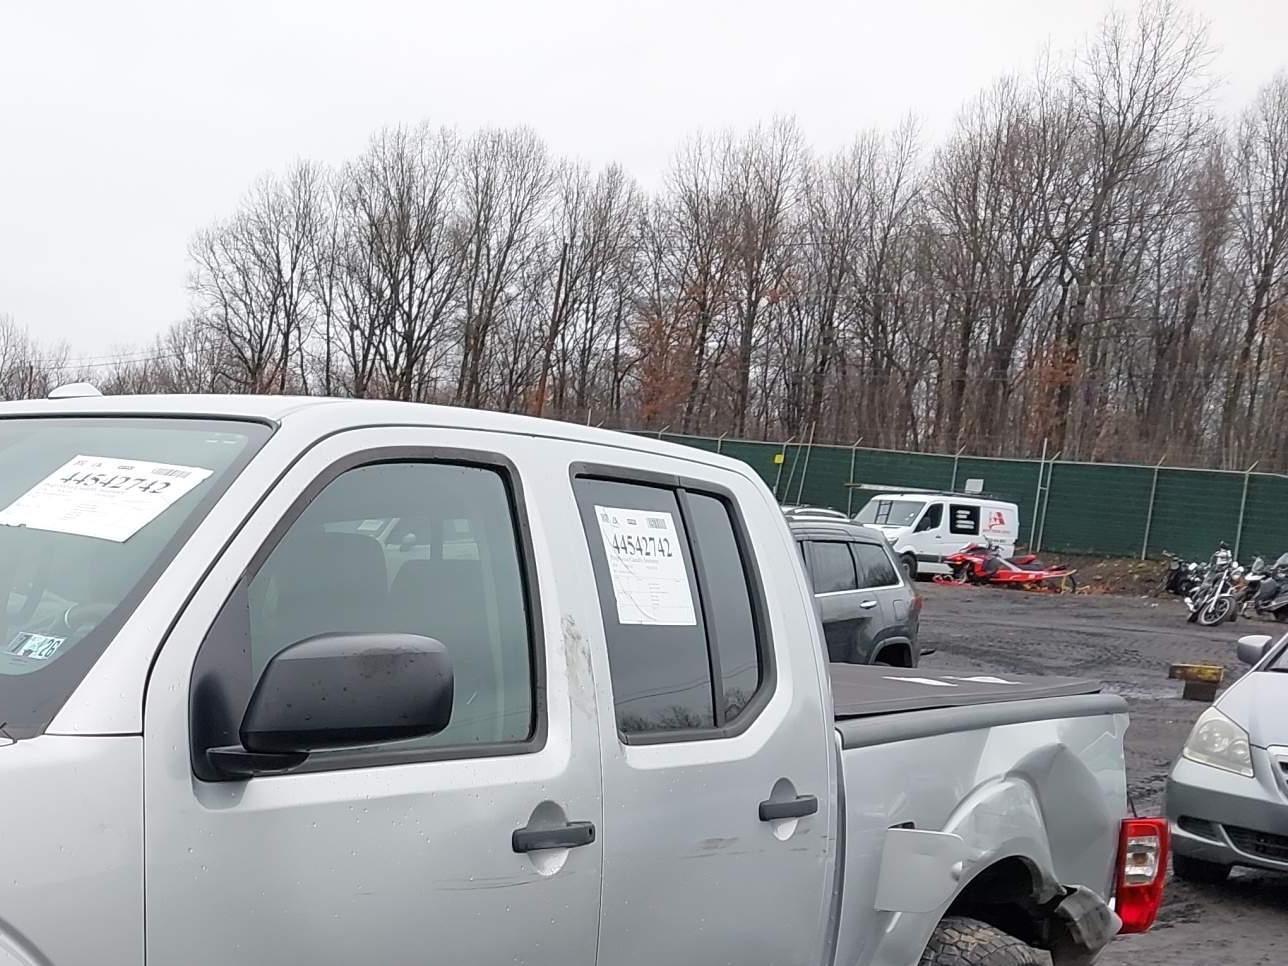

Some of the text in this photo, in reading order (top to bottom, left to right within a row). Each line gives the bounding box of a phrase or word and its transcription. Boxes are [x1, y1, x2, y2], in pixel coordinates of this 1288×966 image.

[60, 472, 171, 494] 44542742
[613, 534, 673, 558] 44542742
[38, 638, 61, 658] 26
